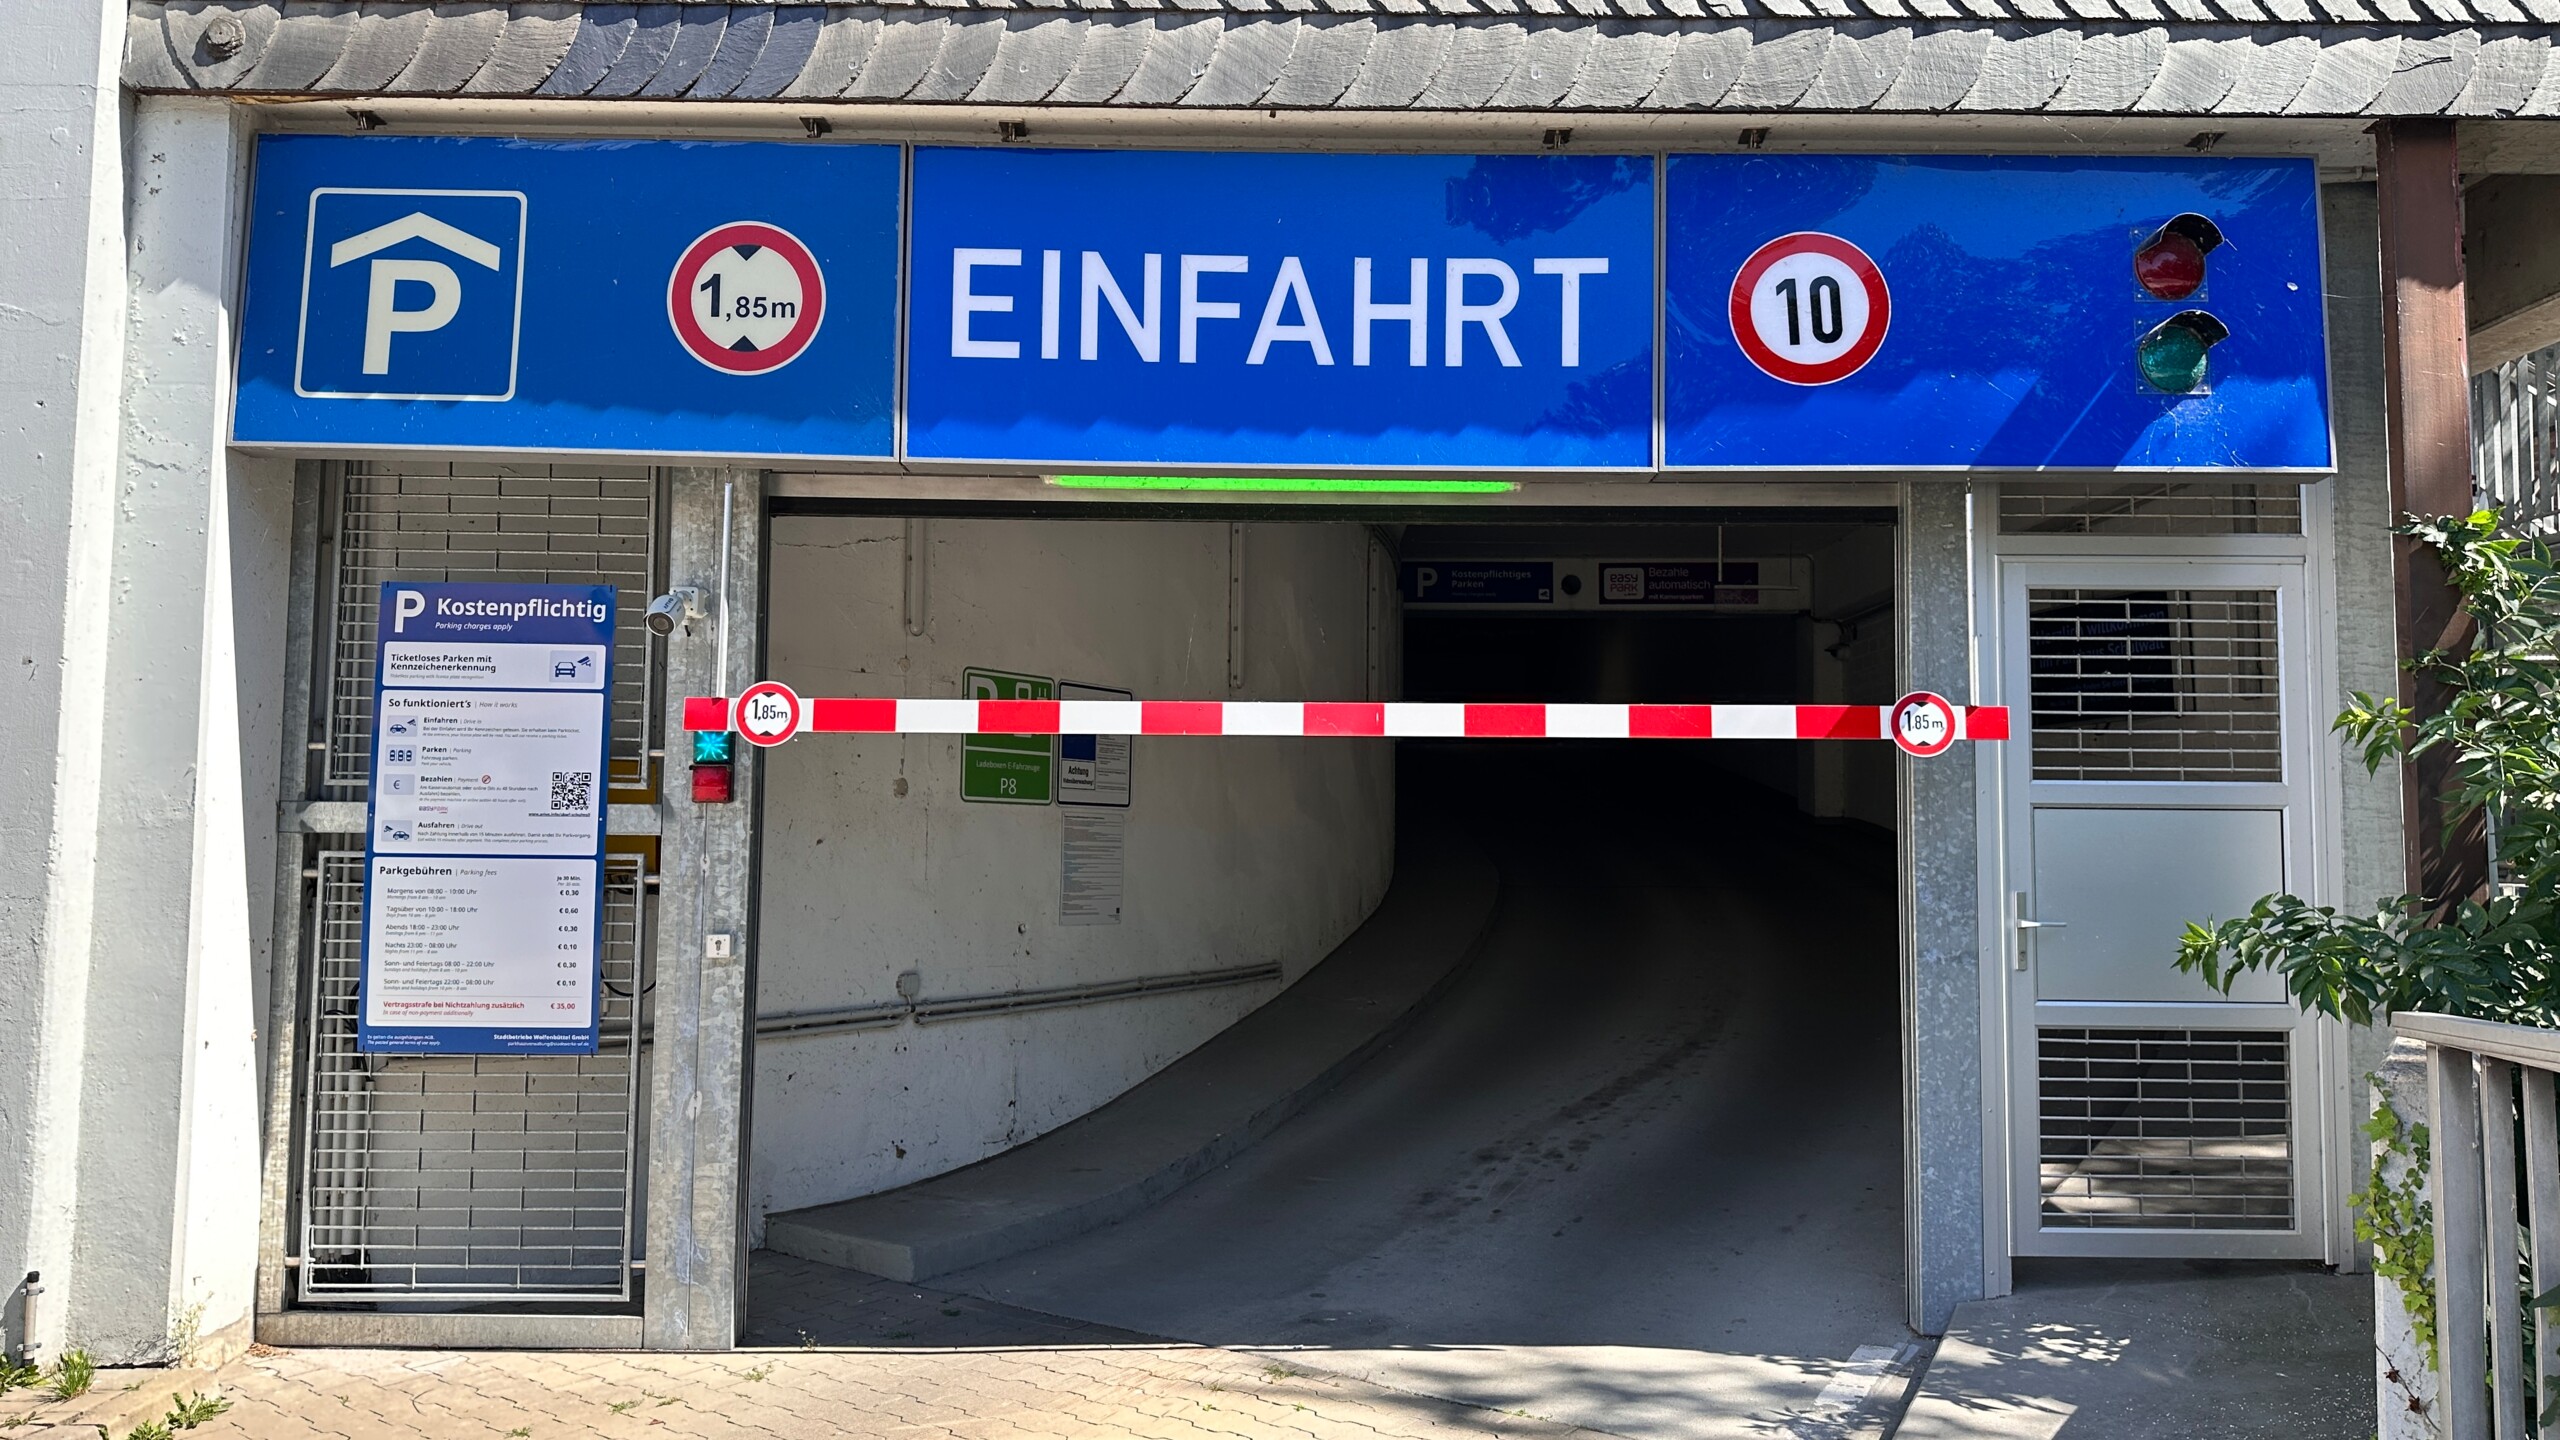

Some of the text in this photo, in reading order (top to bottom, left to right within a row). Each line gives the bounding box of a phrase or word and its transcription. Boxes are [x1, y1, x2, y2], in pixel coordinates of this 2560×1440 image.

[951, 247, 1609, 367] EINFAHRT
[1775, 275, 1843, 345] 10
[363, 259, 461, 375] P
[1451, 569, 1532, 580] Kostenpflichtiges
[1648, 567, 1689, 577] Bezahle
[1416, 567, 1438, 598] P
[1451, 579, 1484, 588] Parken
[1610, 573, 1639, 583] easy
[1648, 579, 1711, 590] automatisch
[394, 590, 425, 633] P
[437, 598, 606, 622] Kostenpflichtig
[435, 622, 513, 632] Parking charges apply
[392, 654, 440, 662] Ticketloses
[443, 655, 474, 663] Parken
[391, 663, 496, 673] Kennzeichenerkennung
[389, 698, 401, 707] So
[976, 759, 1041, 773] Ladeboxen E-Fahrzeuge
[1068, 766, 1089, 778] Achtung
[1000, 778, 1017, 795] P8
[380, 866, 452, 878] Parkgebühren
[460, 869, 497, 877] Parking fees
[416, 960, 443, 968] Feiertags
[383, 1001, 432, 1009] Vertragsstrafe
[445, 1002, 490, 1010] Nichtzahlung
